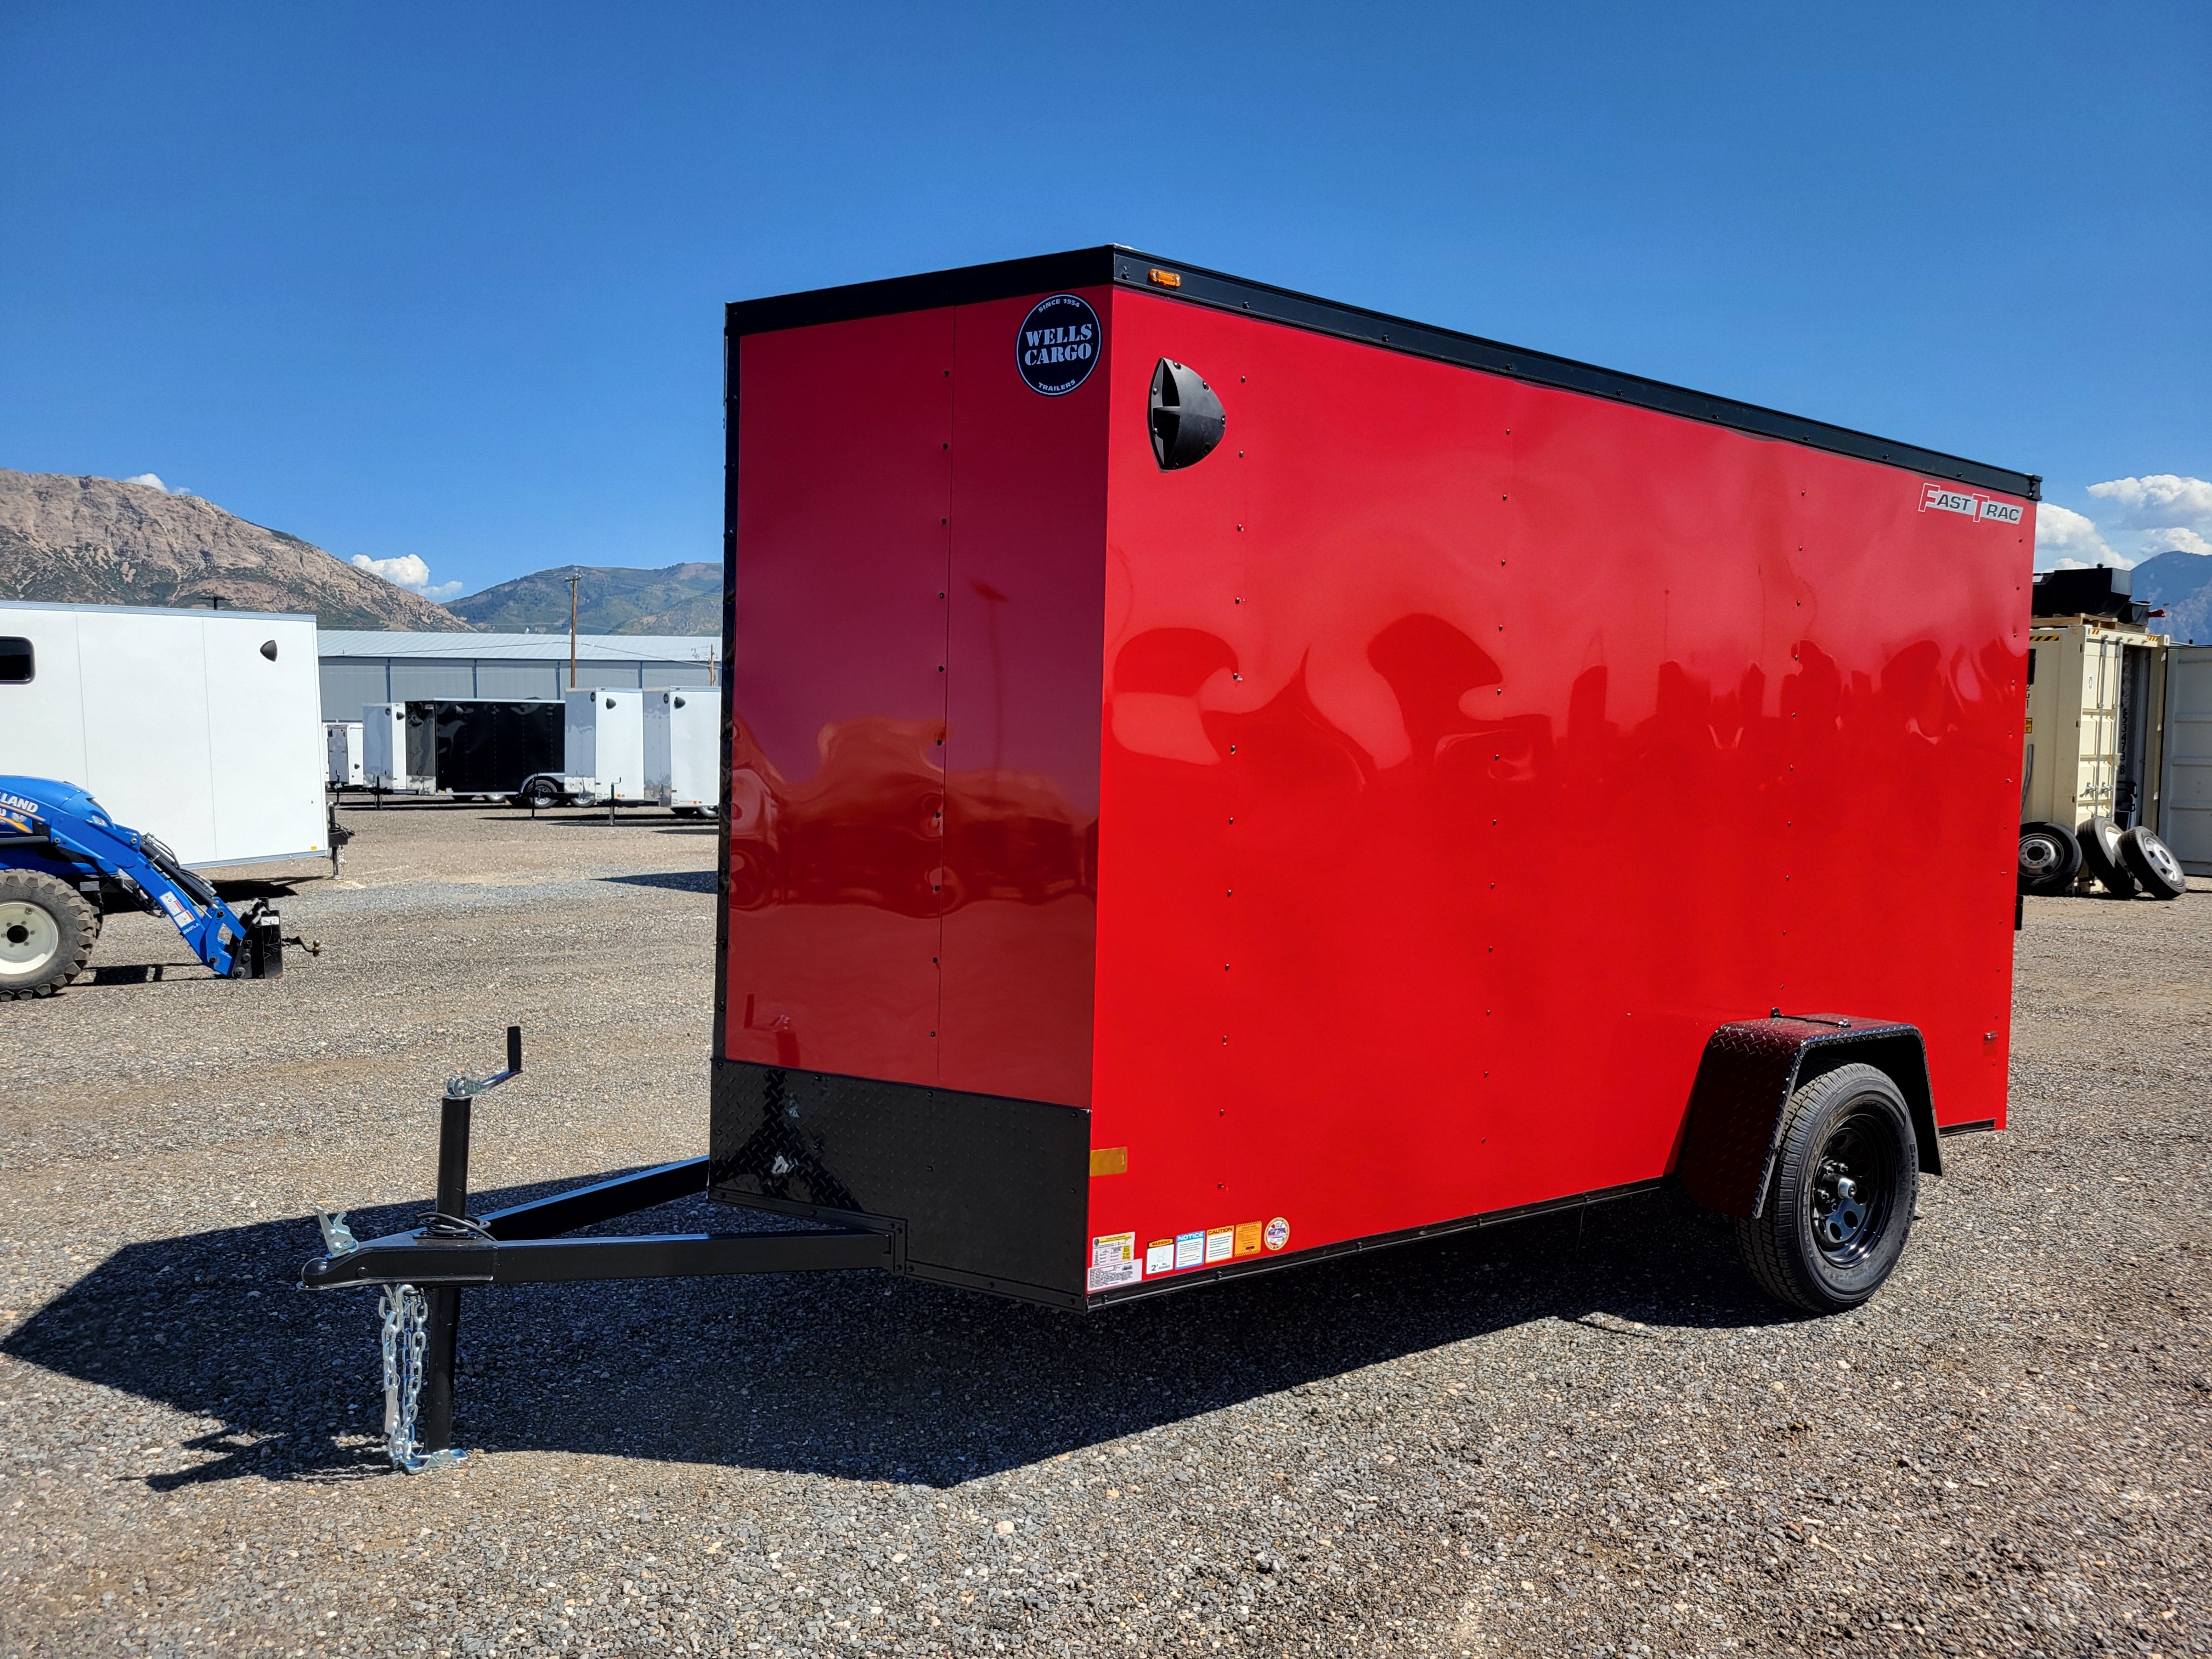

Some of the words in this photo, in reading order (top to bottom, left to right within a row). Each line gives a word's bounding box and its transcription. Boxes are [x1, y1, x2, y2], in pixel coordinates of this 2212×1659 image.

[1038, 298, 1060, 313] SINCE
[1063, 298, 1080, 307] 1954
[1025, 324, 1092, 347] WELLS
[1024, 343, 1092, 365] CARGO
[1038, 379, 1076, 391] TRAILERS
[0, 792, 38, 813] LAND
[1177, 1232, 1204, 1241] NOTICE
[1208, 1227, 1233, 1235] CAUTION
